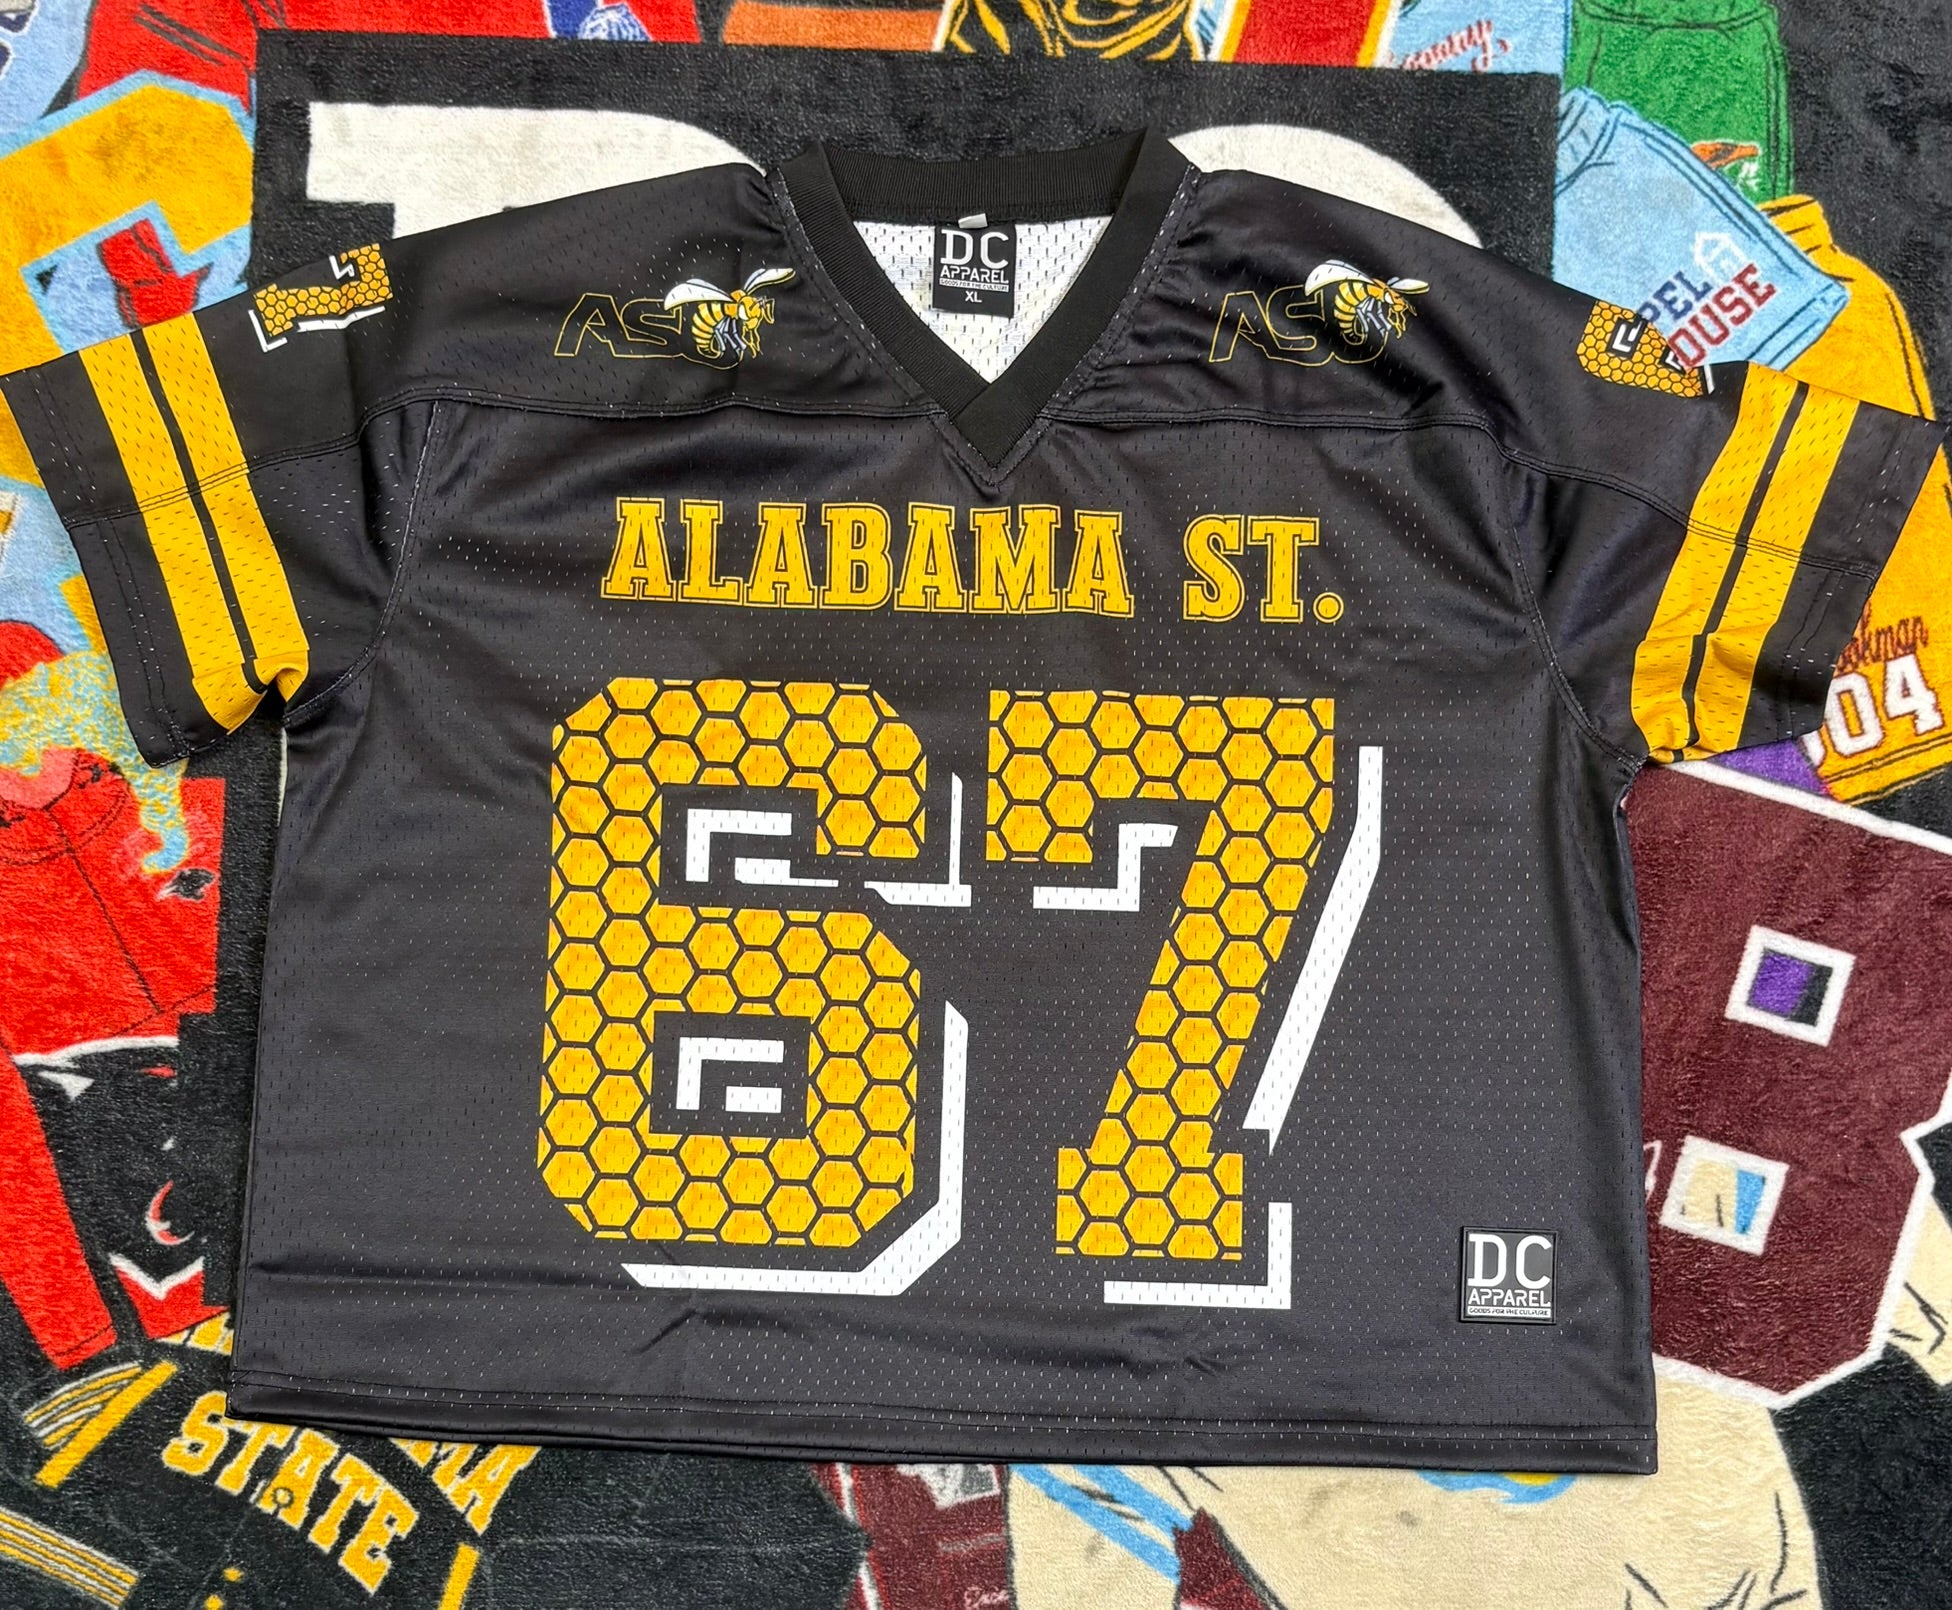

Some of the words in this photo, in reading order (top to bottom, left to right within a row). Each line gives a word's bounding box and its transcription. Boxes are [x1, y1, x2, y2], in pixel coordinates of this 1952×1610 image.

[940, 229, 1009, 269] DC
[940, 264, 1009, 283] APPAREL
[965, 290, 983, 303] XL
[601, 496, 1135, 619] ALABAMA
[1183, 513, 1345, 624] ST.
[1800, 652, 1945, 767] 04
[536, 677, 1383, 1310] 67
[1467, 1233, 1552, 1289] DC
[1468, 1287, 1551, 1307] APPAREL
[161, 1390, 420, 1597] STATE
